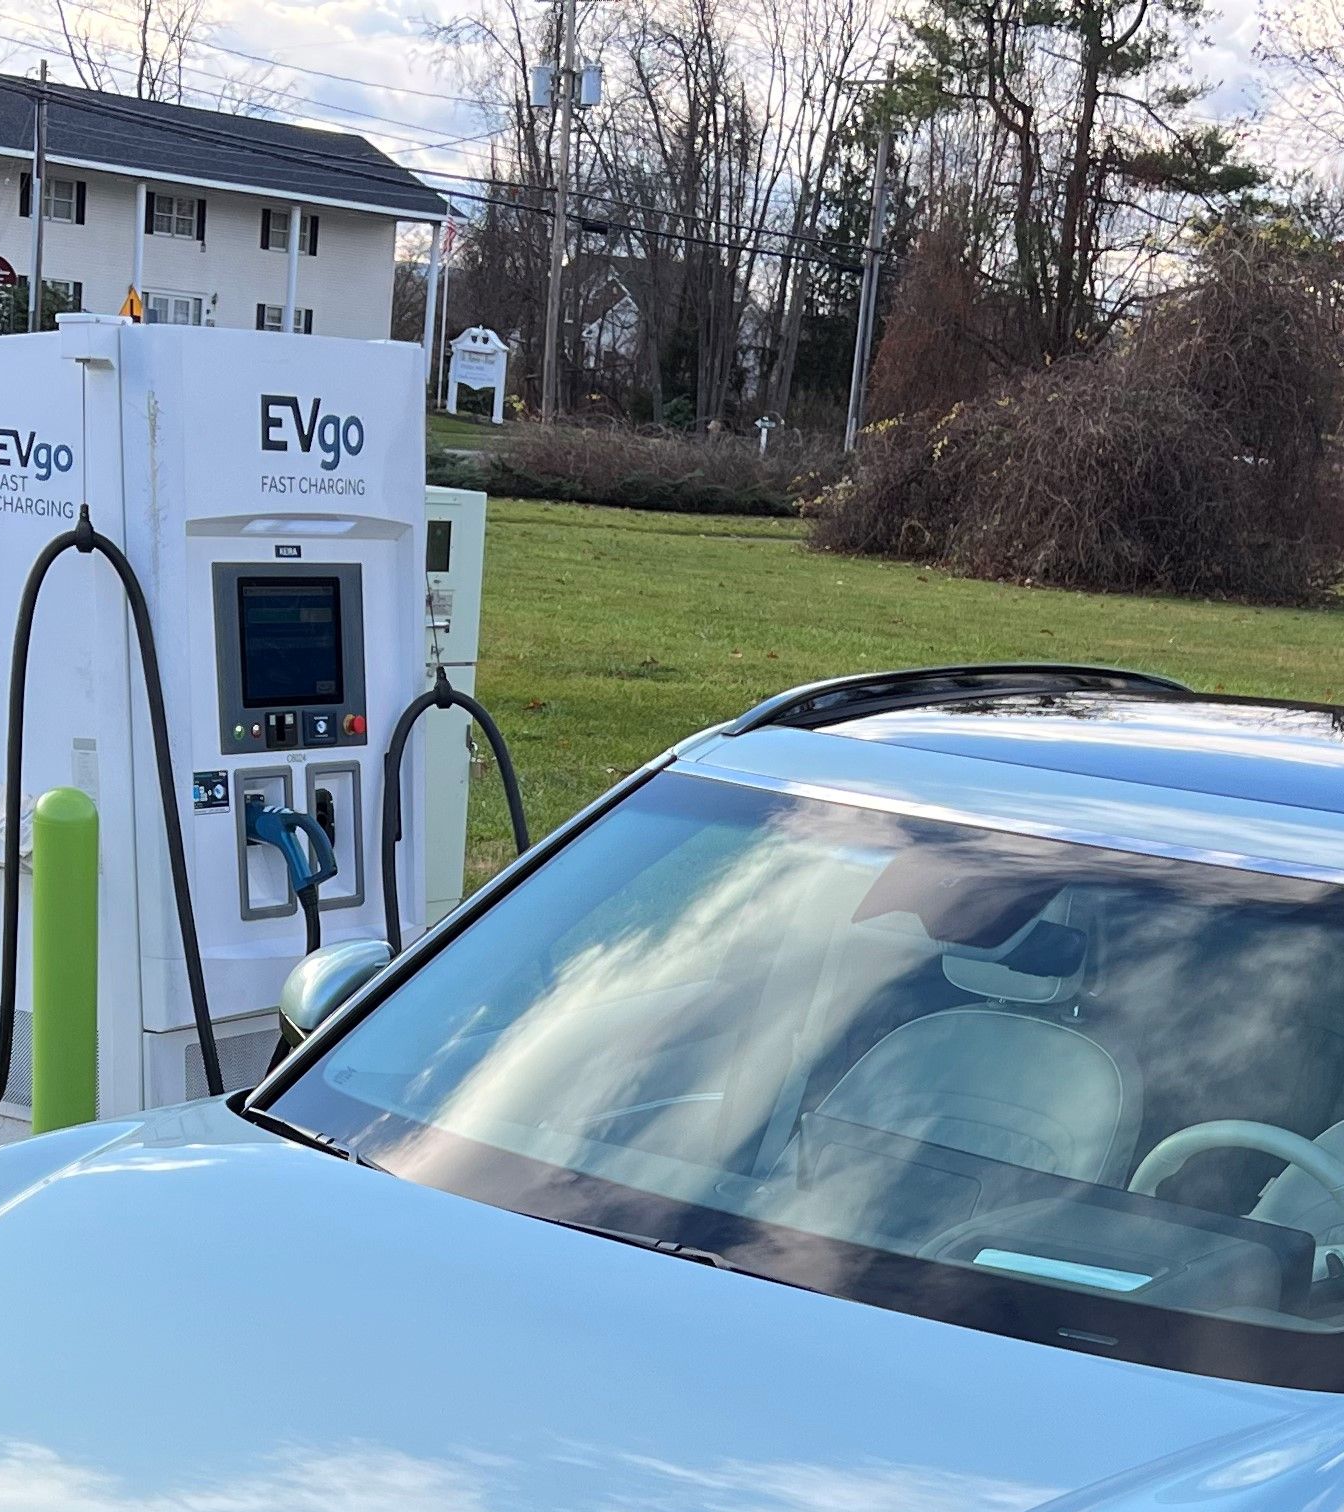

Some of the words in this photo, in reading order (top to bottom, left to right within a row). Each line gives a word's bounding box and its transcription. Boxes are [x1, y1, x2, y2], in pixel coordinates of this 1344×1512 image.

[260, 394, 364, 471] EVgo
[261, 475, 296, 494] FAST
[298, 476, 365, 496] CHARGING
